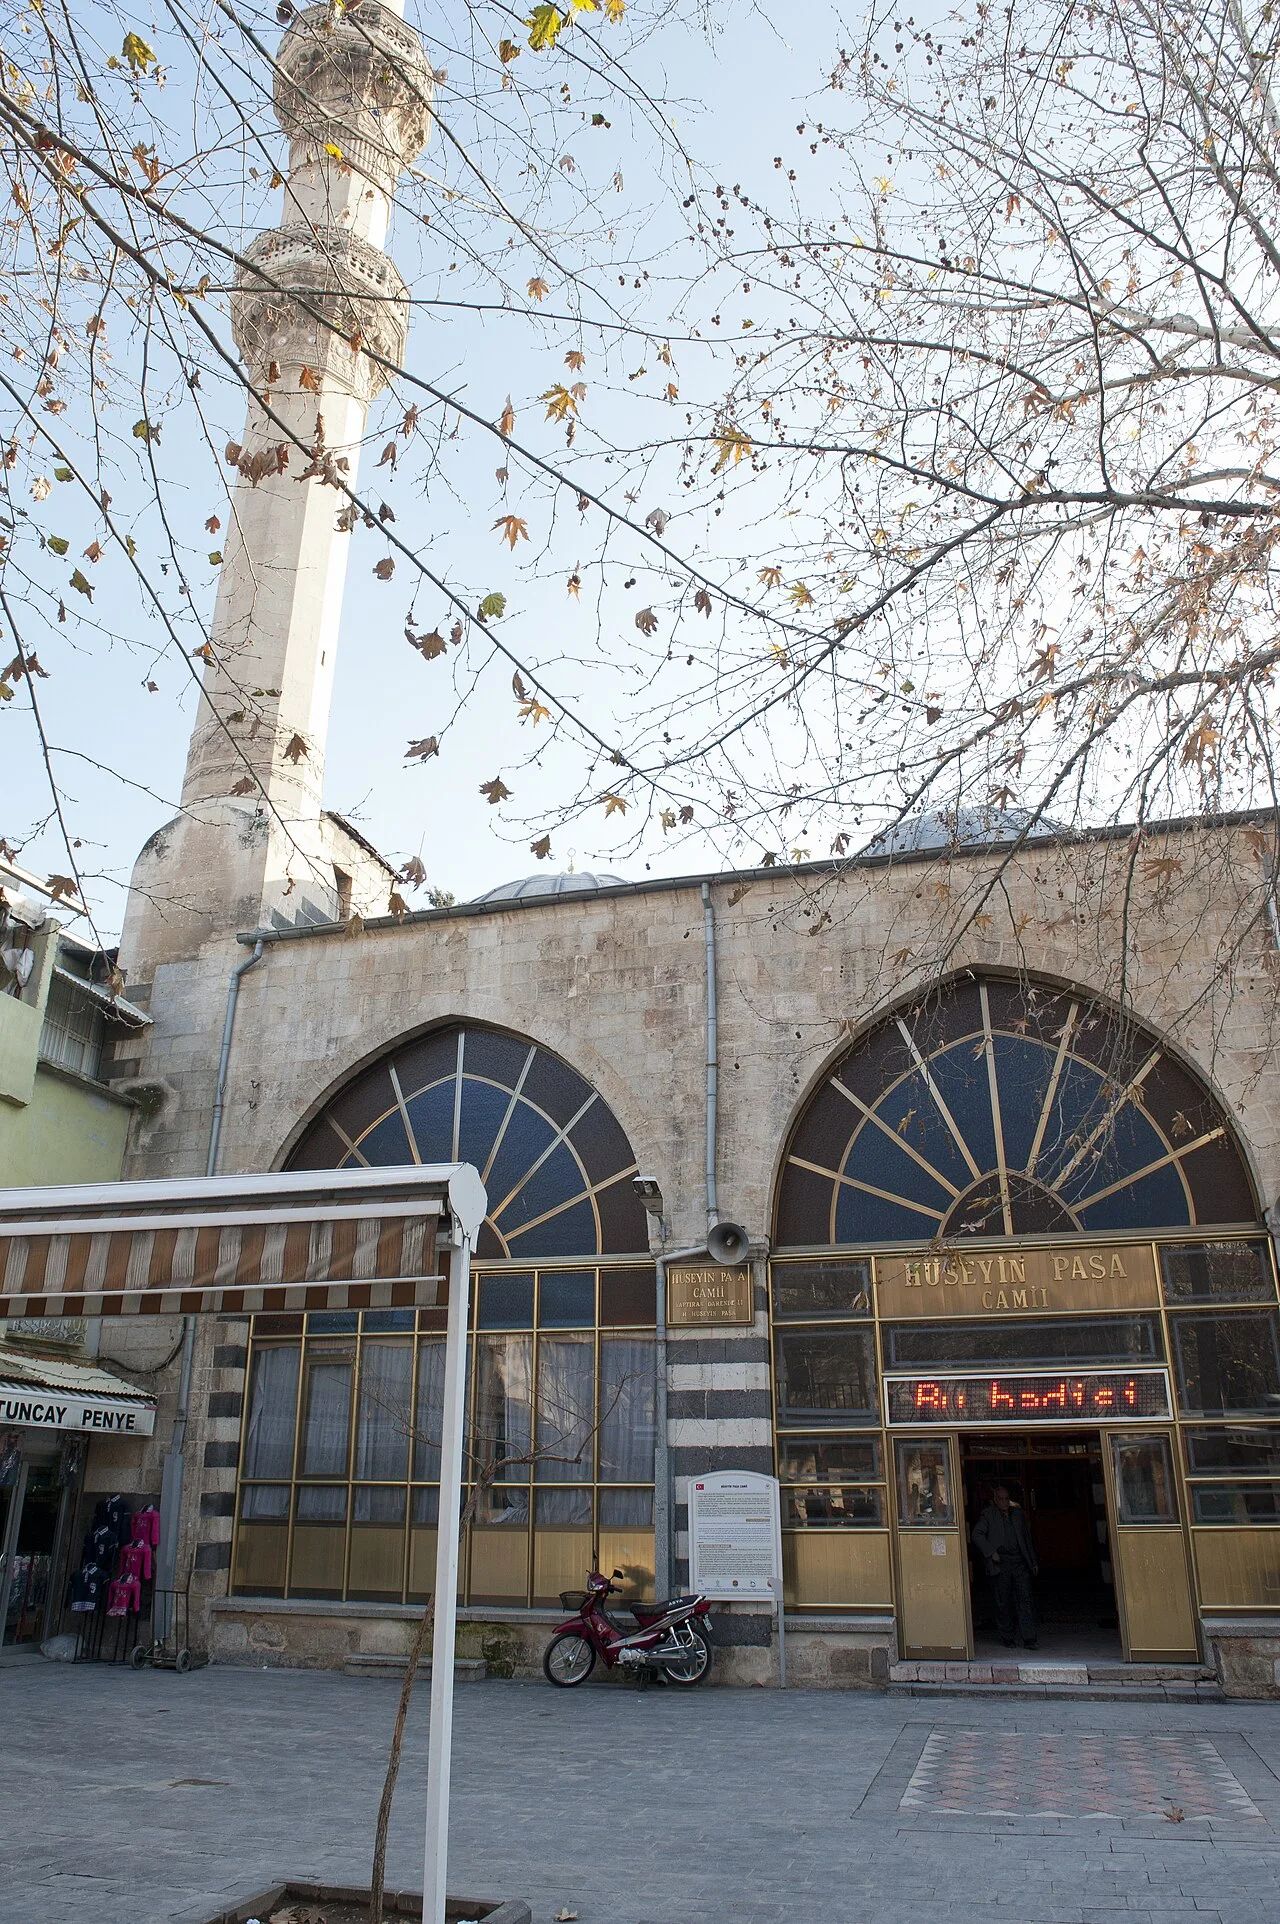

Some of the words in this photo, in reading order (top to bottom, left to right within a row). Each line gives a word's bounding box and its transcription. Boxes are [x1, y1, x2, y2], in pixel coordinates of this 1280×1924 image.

[904, 1256, 1027, 1287] HÜSEYİN
[1052, 1253, 1127, 1283] PAŞA
[82, 1409, 136, 1430] PENYE
